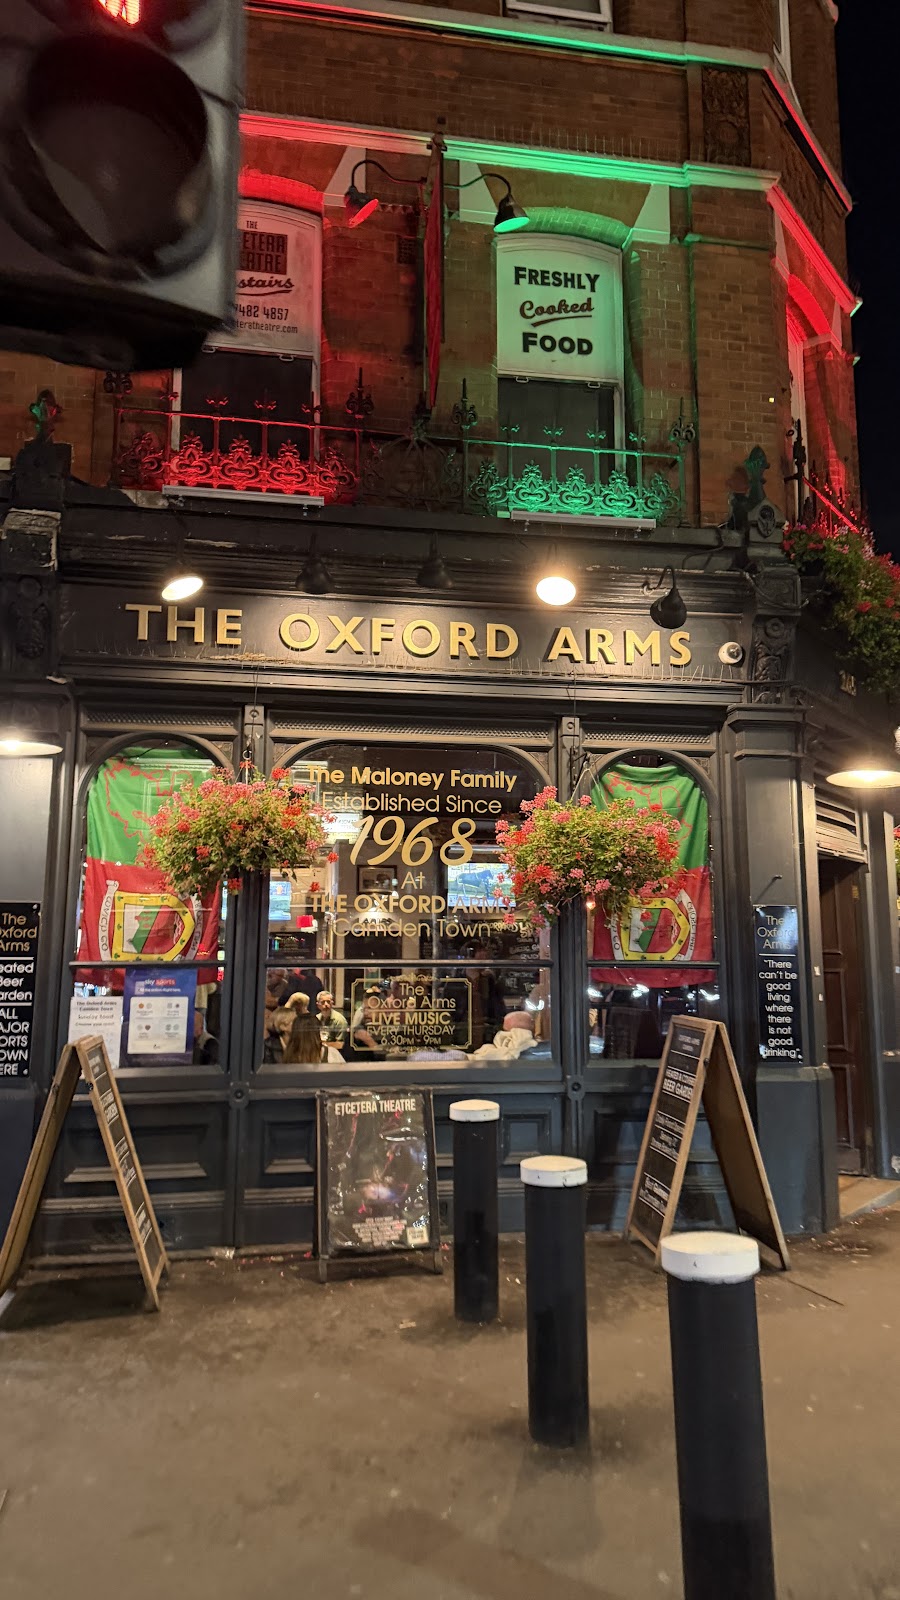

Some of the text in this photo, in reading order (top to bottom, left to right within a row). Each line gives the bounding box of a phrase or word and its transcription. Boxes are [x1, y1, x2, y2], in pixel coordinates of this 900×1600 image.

[246, 221, 258, 230] THE
[243, 231, 286, 254] ETERA
[237, 276, 295, 289] stairs
[514, 266, 600, 293] FRESHLY
[263, 307, 289, 321] 4857
[519, 297, 594, 321] Cooked
[236, 319, 299, 334] teratheatre.com
[522, 332, 594, 356] FOOD
[125, 603, 692, 667] THE OXFORD ARMS
[307, 765, 517, 792] The Maloney Family
[321, 791, 502, 814] Established Since
[350, 814, 477, 867] 1968
[401, 872, 426, 890] At
[310, 894, 348, 914] THE
[354, 894, 446, 914] OXFORD
[1, 911, 28, 926] The
[765, 915, 785, 926] The
[0, 925, 38, 939] xford
[332, 918, 431, 938] Camden
[436, 918, 491, 938] Town
[0, 962, 35, 974] eated
[784, 971, 798, 980] be
[399, 982, 425, 996] The
[765, 981, 792, 992] good
[0, 989, 33, 1001] arden
[367, 995, 457, 1009] Oxford Arms
[767, 992, 790, 1003] living
[764, 1003, 794, 1013] where
[371, 1011, 451, 1026] LIVE MUSIC
[768, 1014, 792, 1024] there
[0, 1021, 30, 1034] AJOR
[366, 1025, 456, 1036] EVERY THURSDAY
[768, 1025, 792, 1035] is not
[0, 1035, 28, 1048] ORTS
[380, 1035, 415, 1047] 6.30PM
[422, 1034, 442, 1046] 9PM
[768, 1036, 794, 1047] good
[0, 1049, 28, 1062] OWN
[0, 1063, 19, 1076] ERE
[662, 1078, 676, 1093] BEER
[335, 1098, 416, 1116] ETCETERA THEATRE
